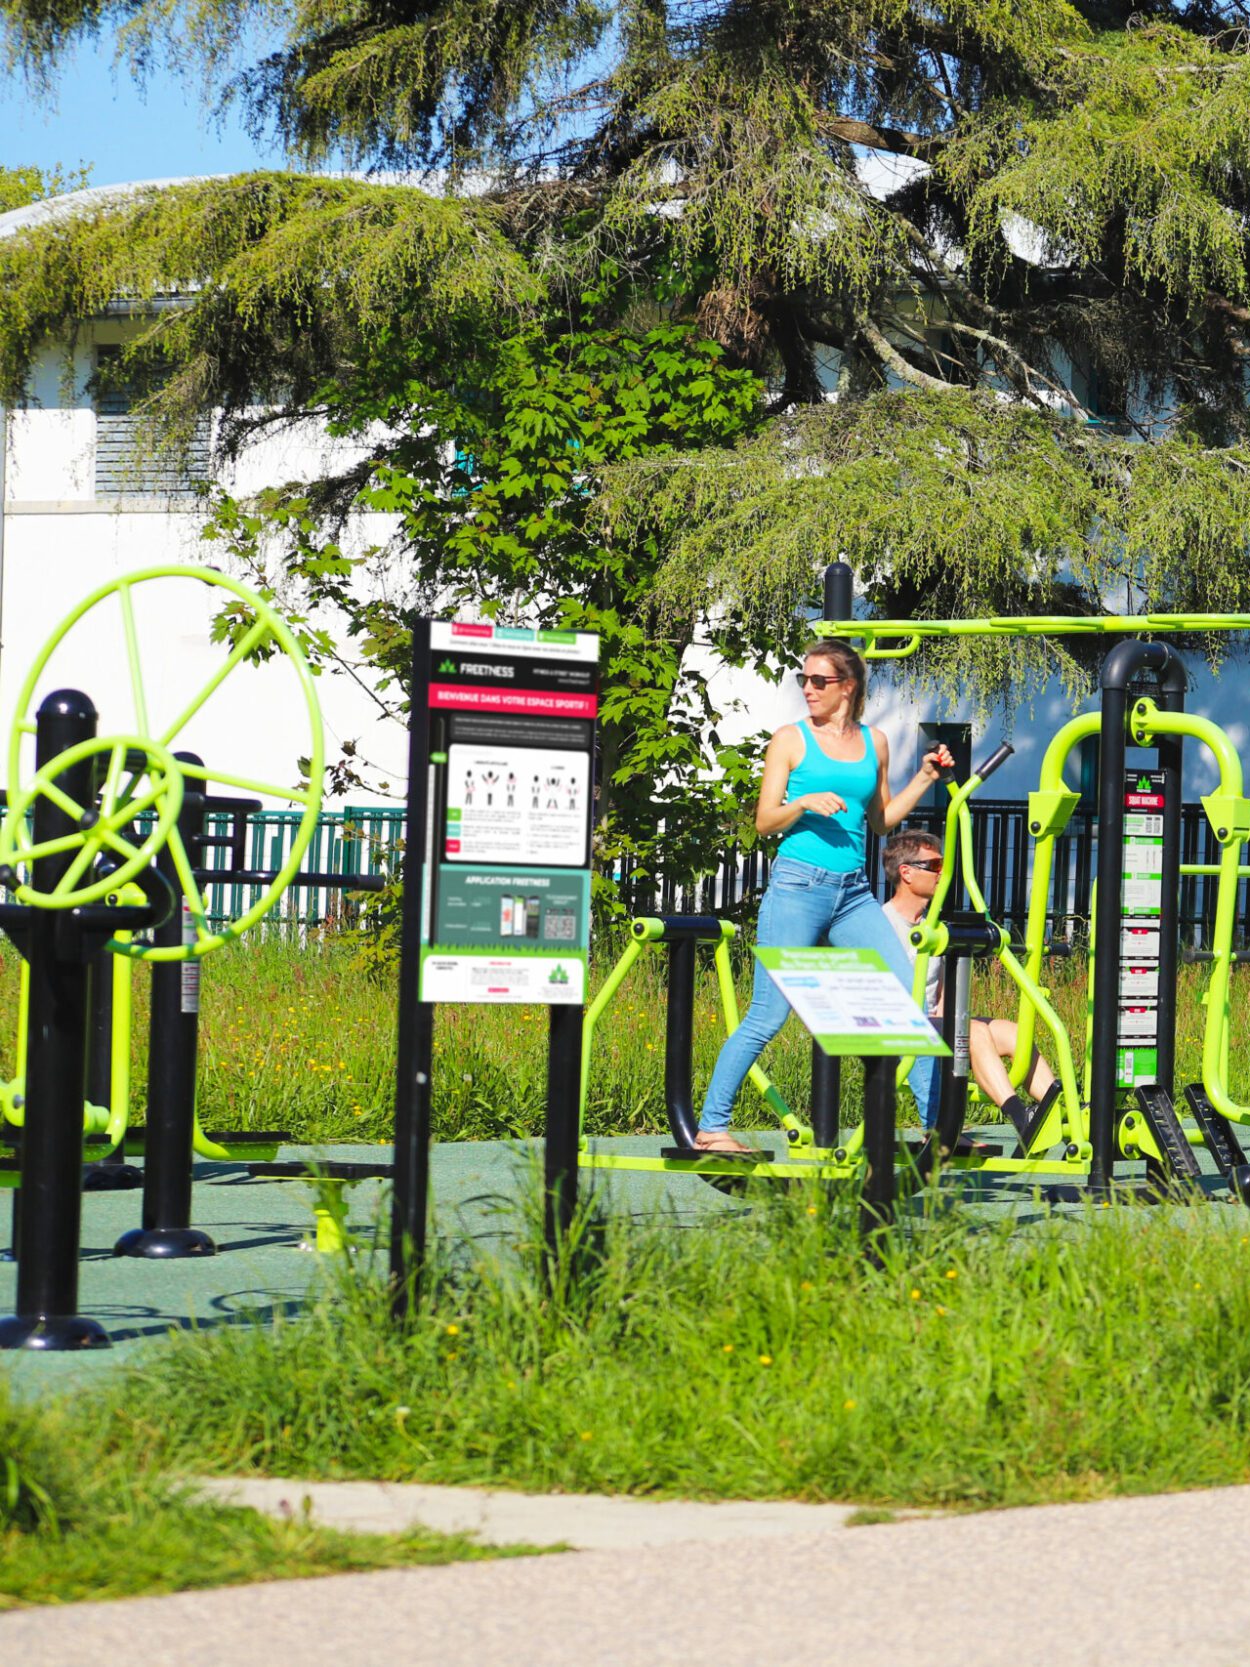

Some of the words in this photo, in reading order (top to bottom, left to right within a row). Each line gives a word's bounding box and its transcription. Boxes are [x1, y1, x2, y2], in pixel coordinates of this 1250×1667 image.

[460, 662, 515, 678] FREETNESS
[437, 691, 479, 703] BIENVENUE
[481, 693, 501, 704] DANS
[502, 694, 526, 706] VOTRE
[527, 696, 554, 708] ESPACE
[555, 698, 584, 710] SPORTIF
[465, 875, 512, 886] APPLICATION
[512, 876, 551, 888] FREETNESS
